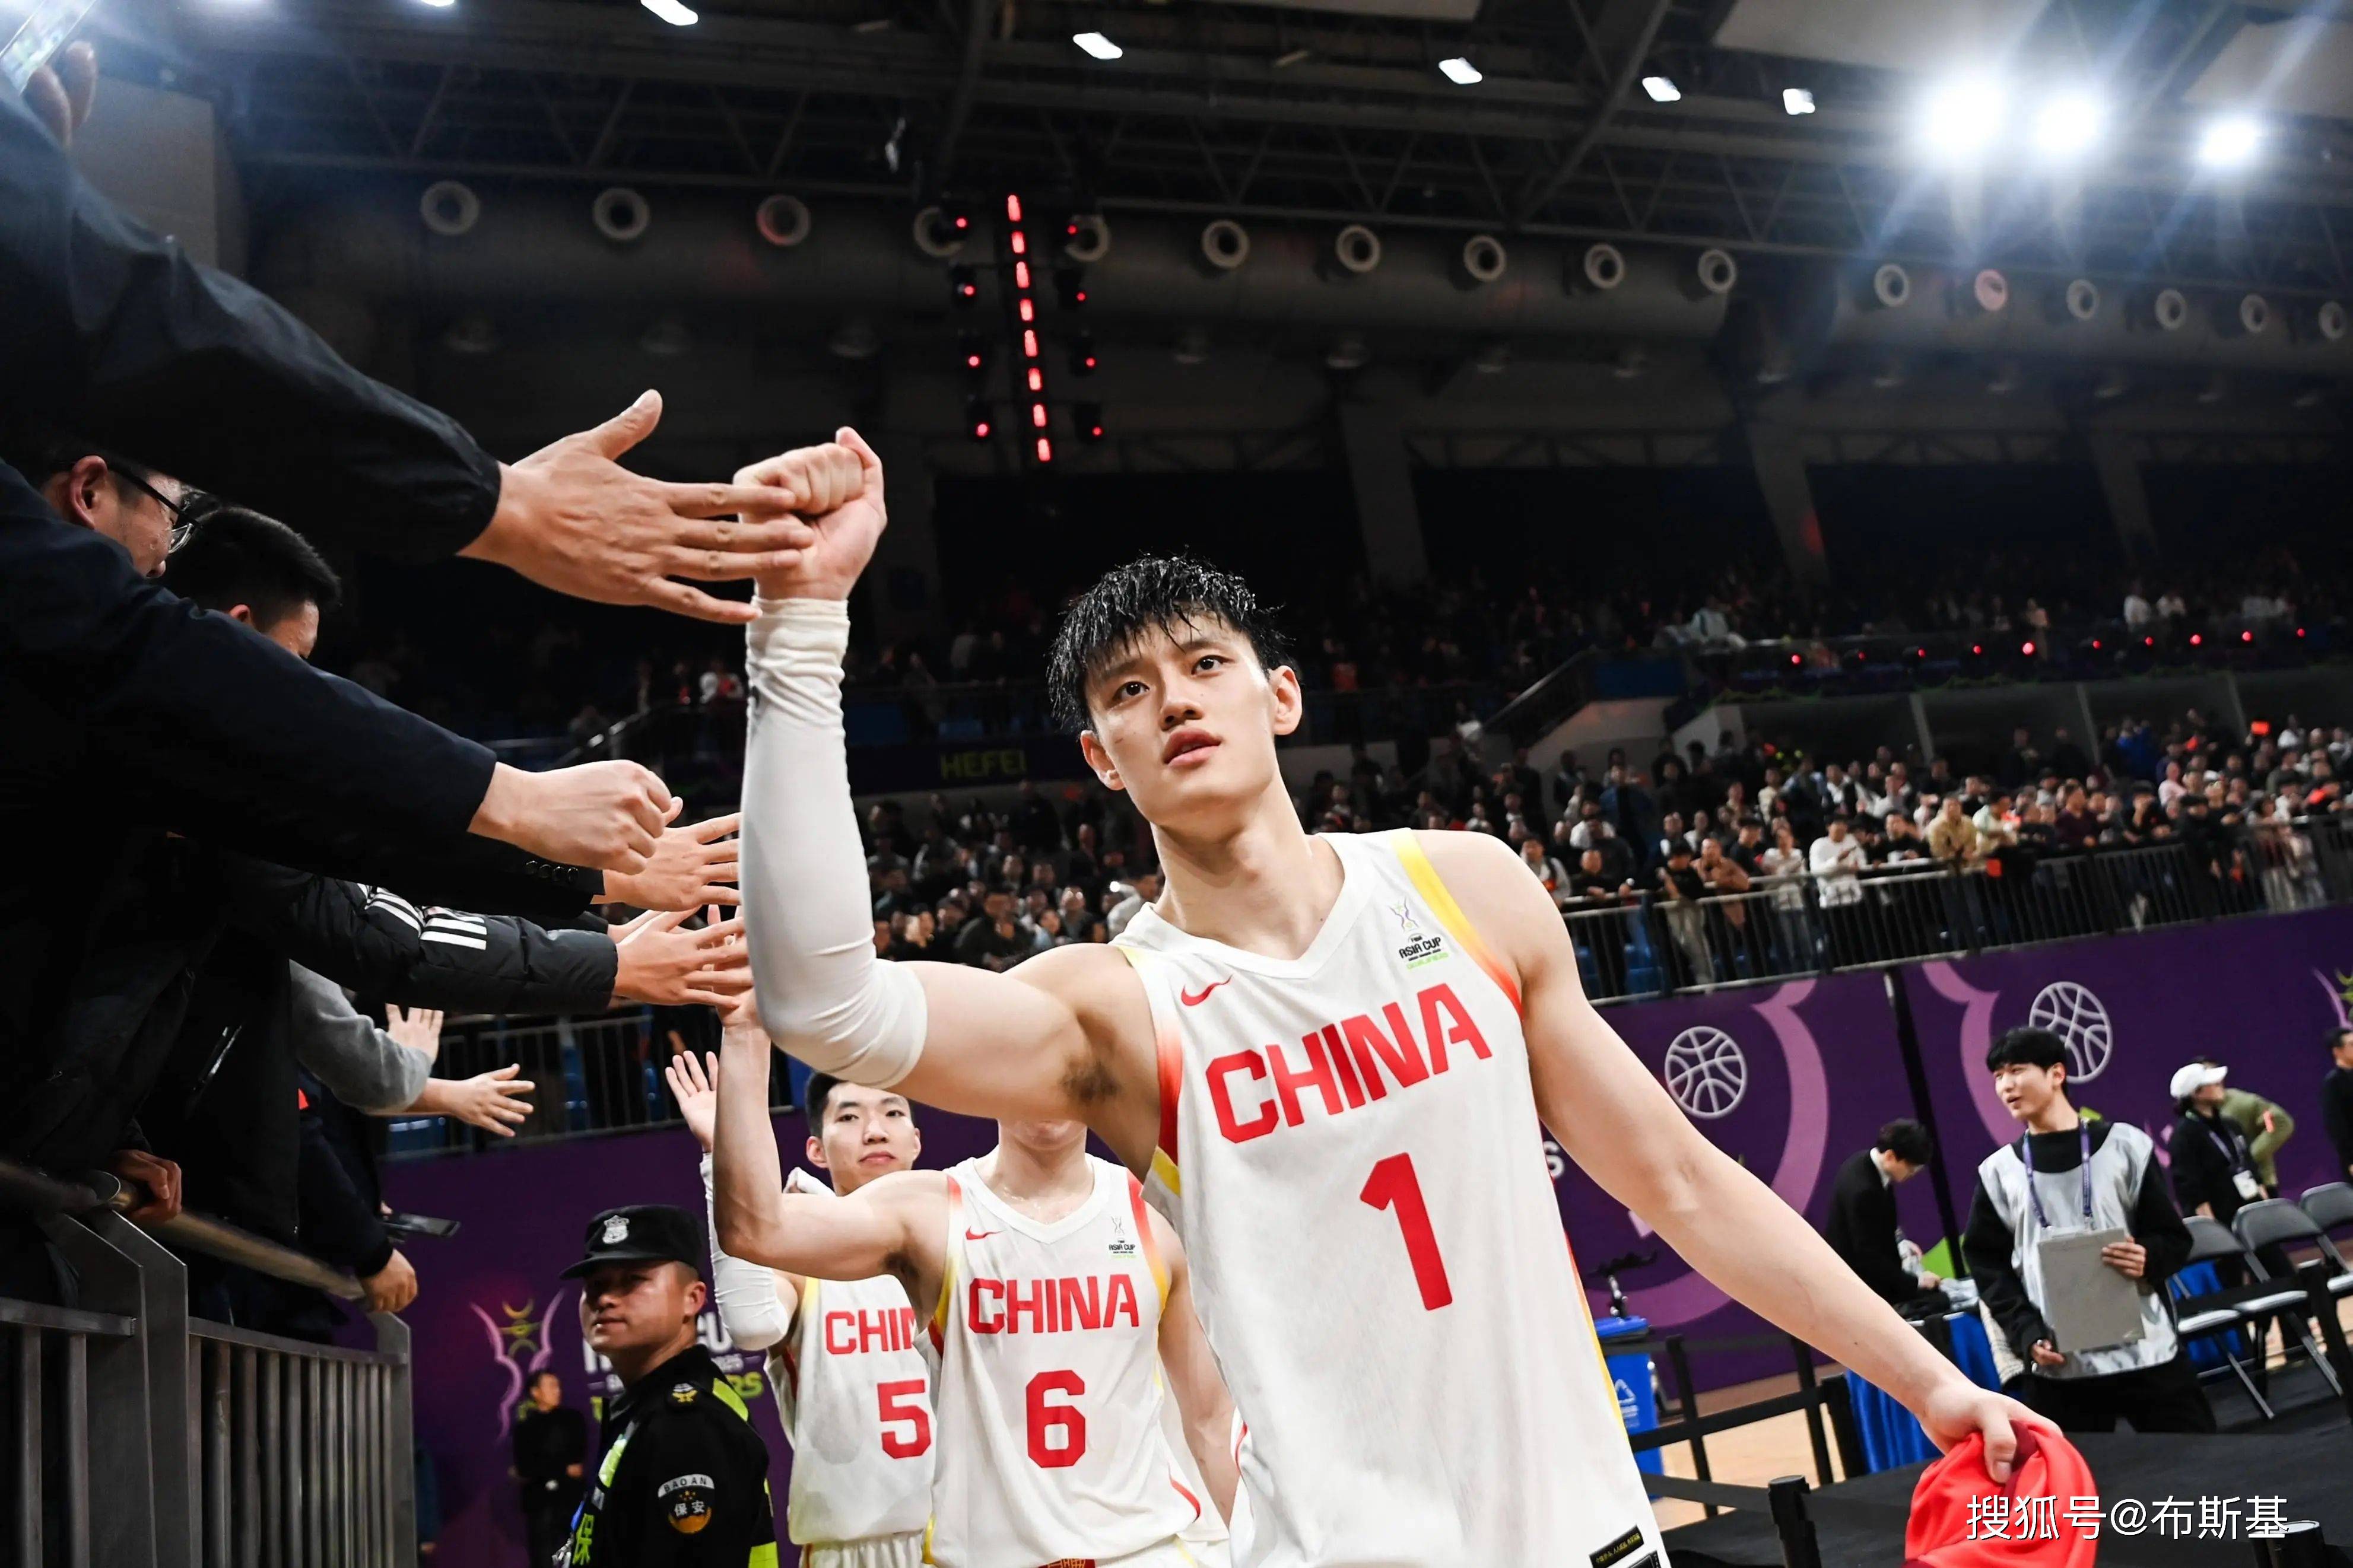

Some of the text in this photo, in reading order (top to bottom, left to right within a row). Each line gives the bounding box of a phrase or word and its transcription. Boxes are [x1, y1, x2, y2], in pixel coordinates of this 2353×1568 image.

[1399, 943, 1423, 959] ASIA
[1424, 936, 1441, 950] CUP
[1205, 982, 1493, 1144] CHINA
[1360, 1152, 1453, 1311] 1
[968, 1274, 1139, 1334] CHINA
[877, 1379, 931, 1459] 5
[1025, 1369, 1086, 1468] 6
[674, 1500, 705, 1517] 保安
